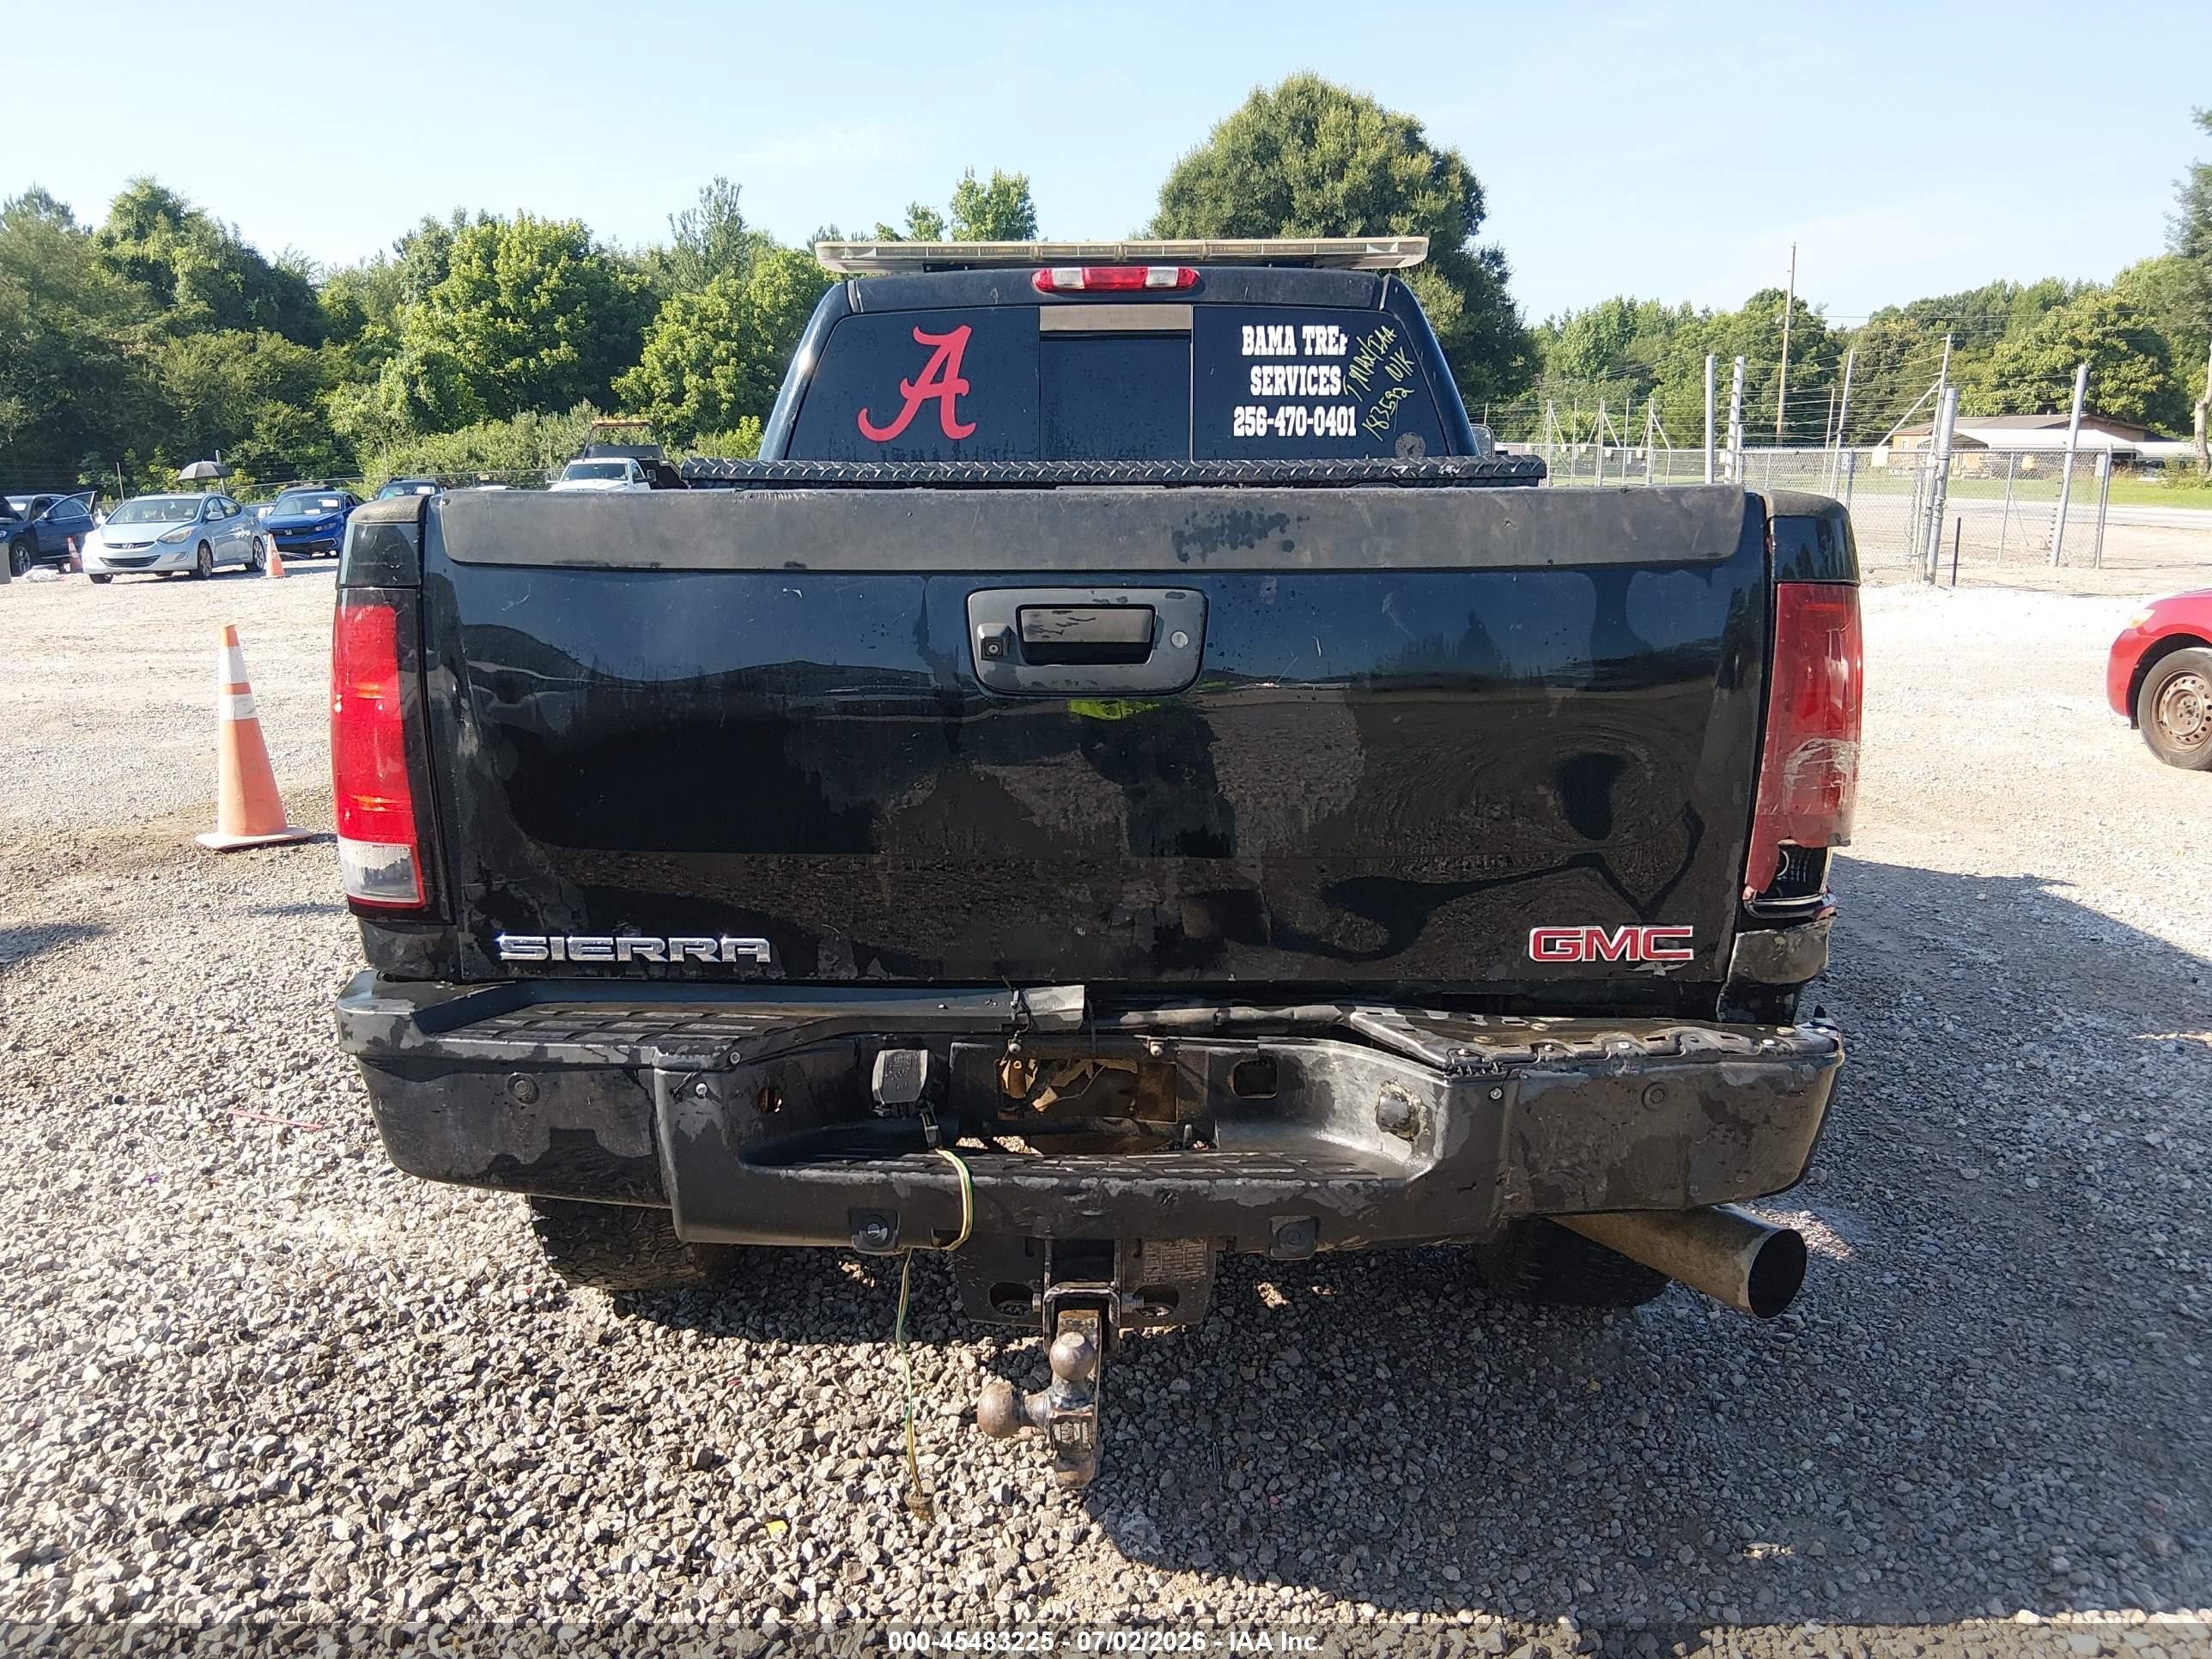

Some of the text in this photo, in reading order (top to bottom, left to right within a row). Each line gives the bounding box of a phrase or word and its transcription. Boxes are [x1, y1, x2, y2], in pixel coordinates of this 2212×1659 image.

[1242, 325, 1297, 356] BAMA
[858, 325, 976, 442] A
[1250, 365, 1342, 396] SERVICES
[1233, 405, 1357, 437] 256-470-0401
[497, 934, 771, 963] SIERRA
[1528, 925, 1694, 963] GMC
